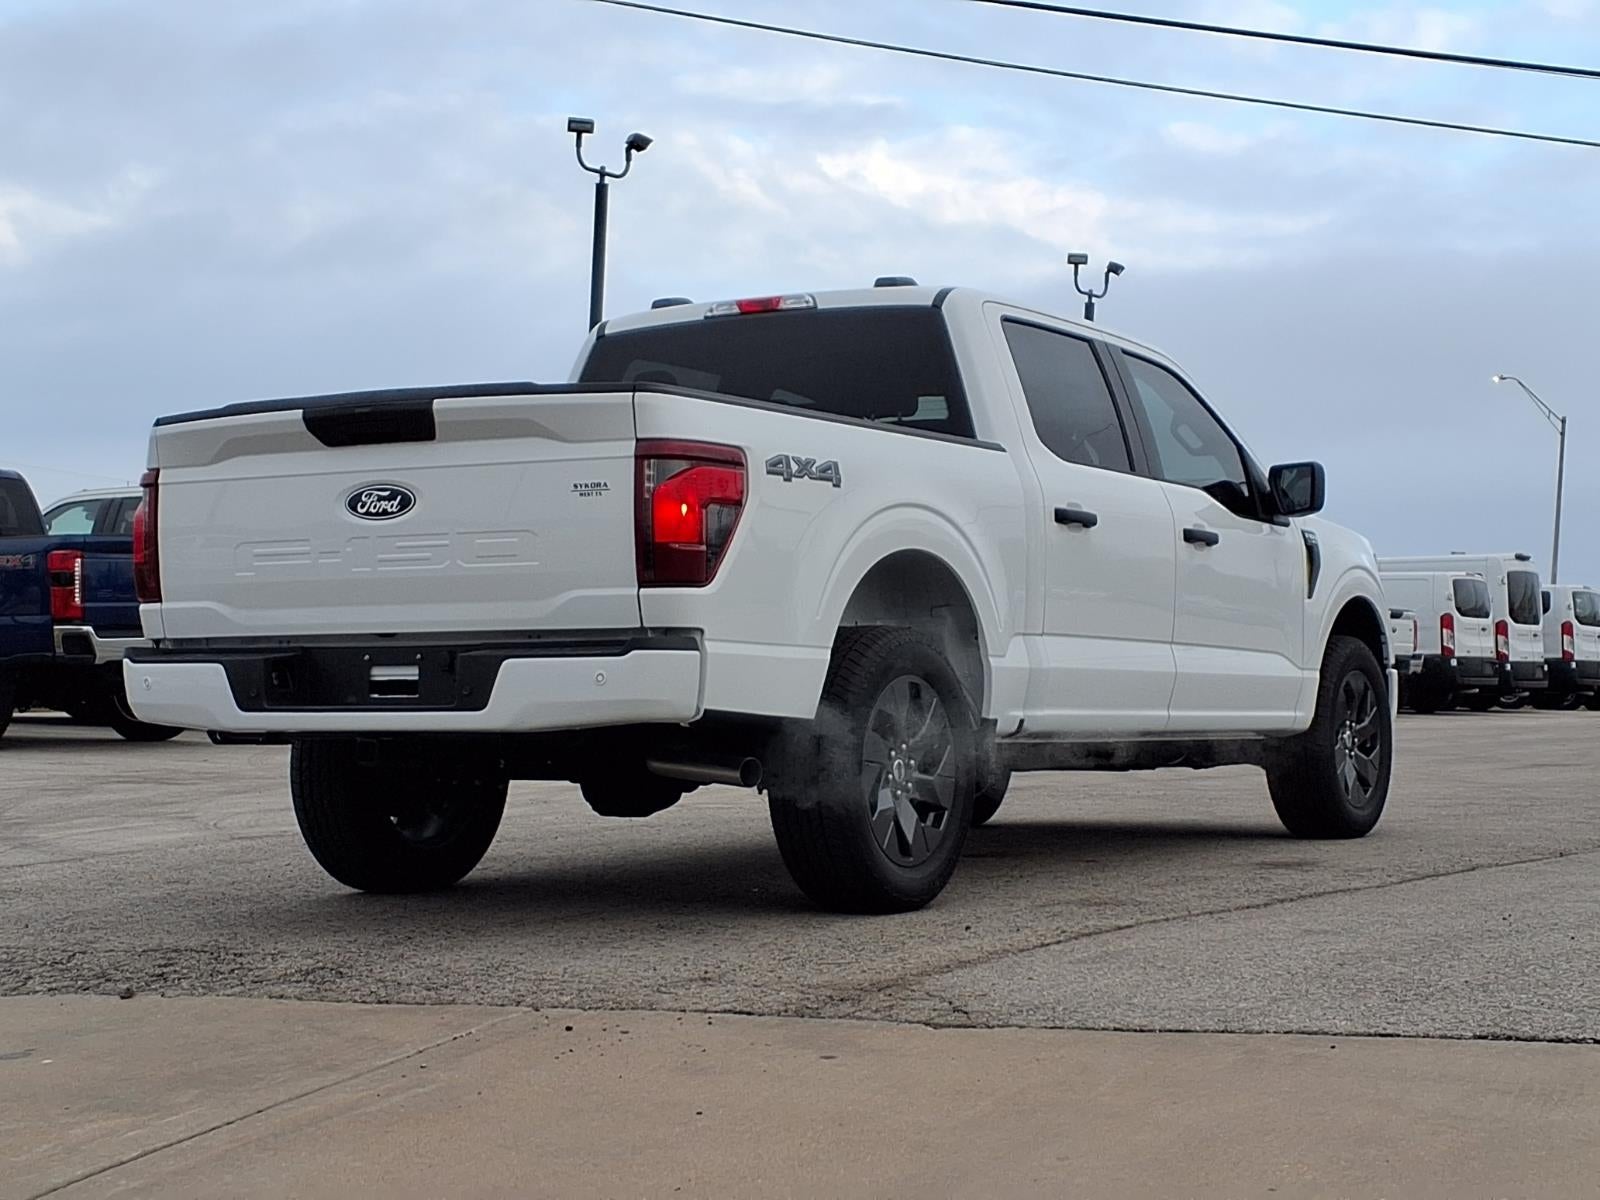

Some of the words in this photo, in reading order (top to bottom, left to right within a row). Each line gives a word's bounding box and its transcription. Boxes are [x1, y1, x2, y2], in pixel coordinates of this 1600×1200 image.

[573, 481, 608, 489] SYKORA
[357, 490, 402, 513] Ford
[234, 529, 540, 576] F-150
